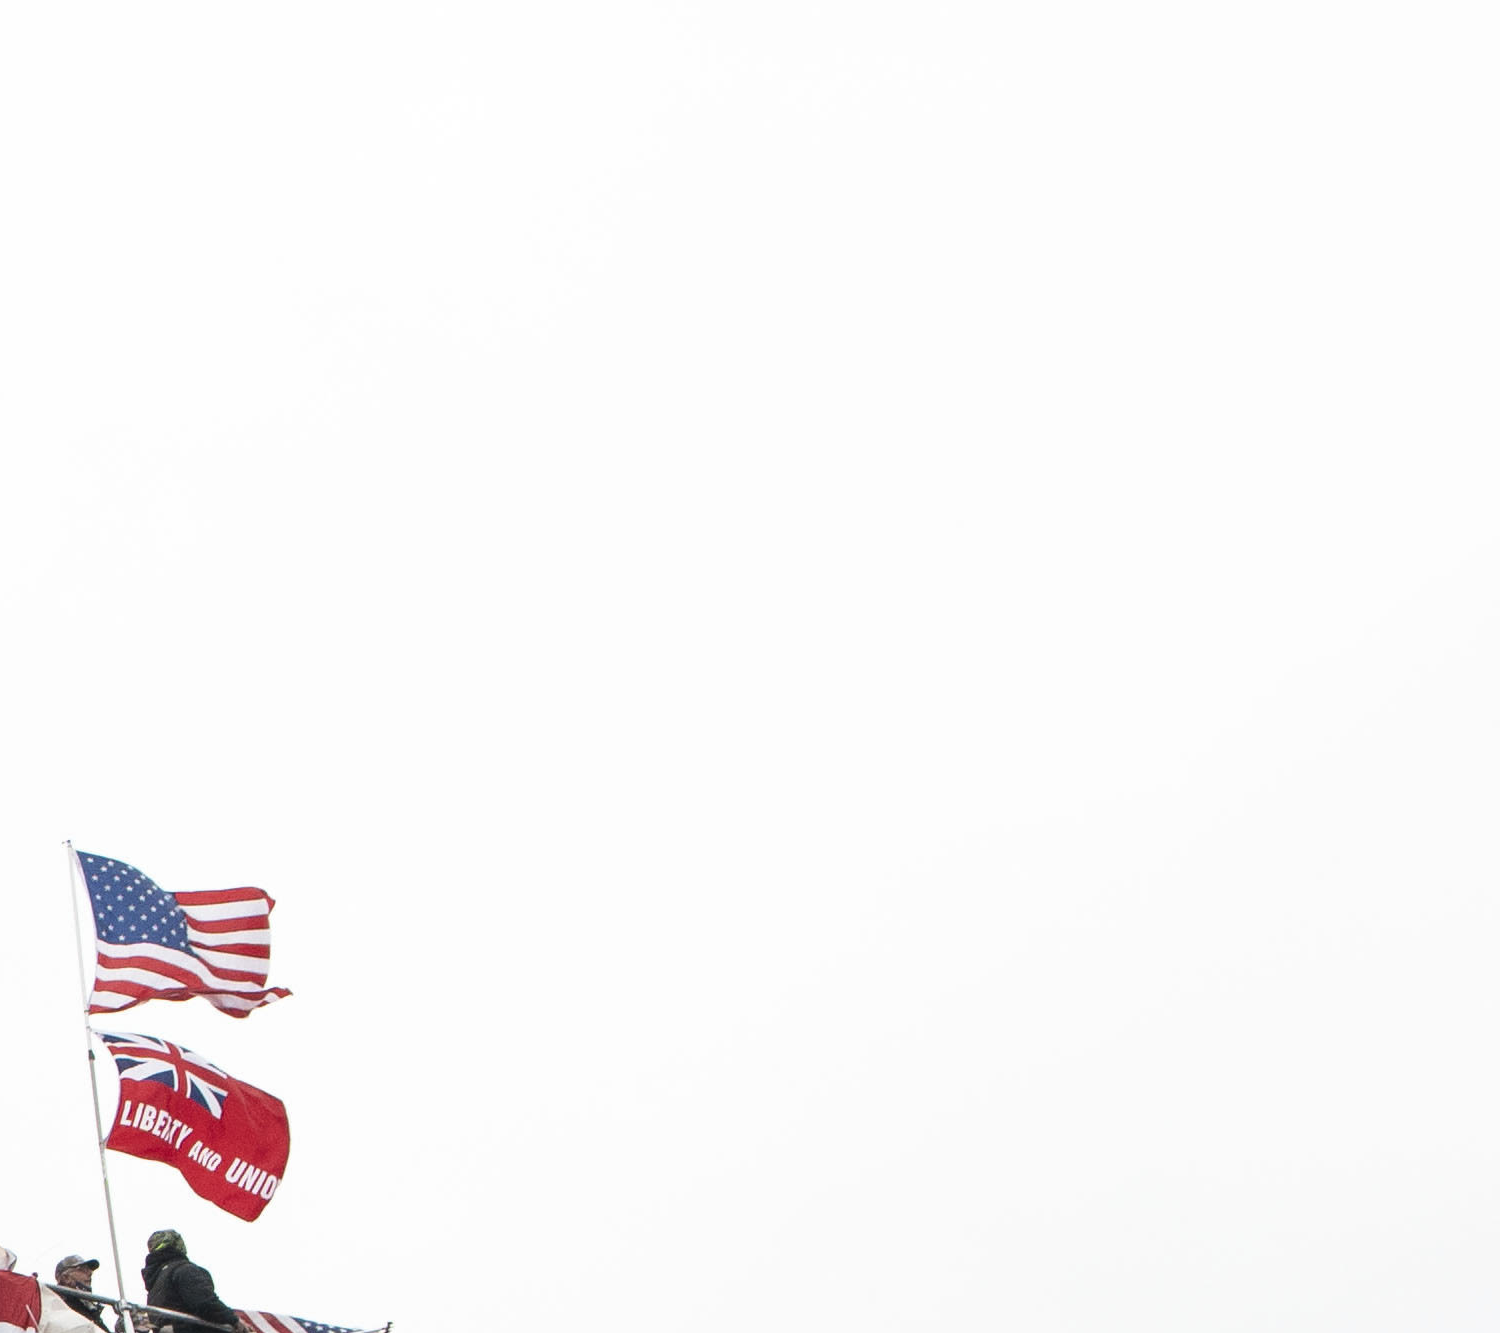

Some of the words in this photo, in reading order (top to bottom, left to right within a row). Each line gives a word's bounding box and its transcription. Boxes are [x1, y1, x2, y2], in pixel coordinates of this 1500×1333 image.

[120, 1100, 193, 1150] LIBERTY
[188, 1140, 222, 1172] AND
[225, 1157, 283, 1201] UNIO
